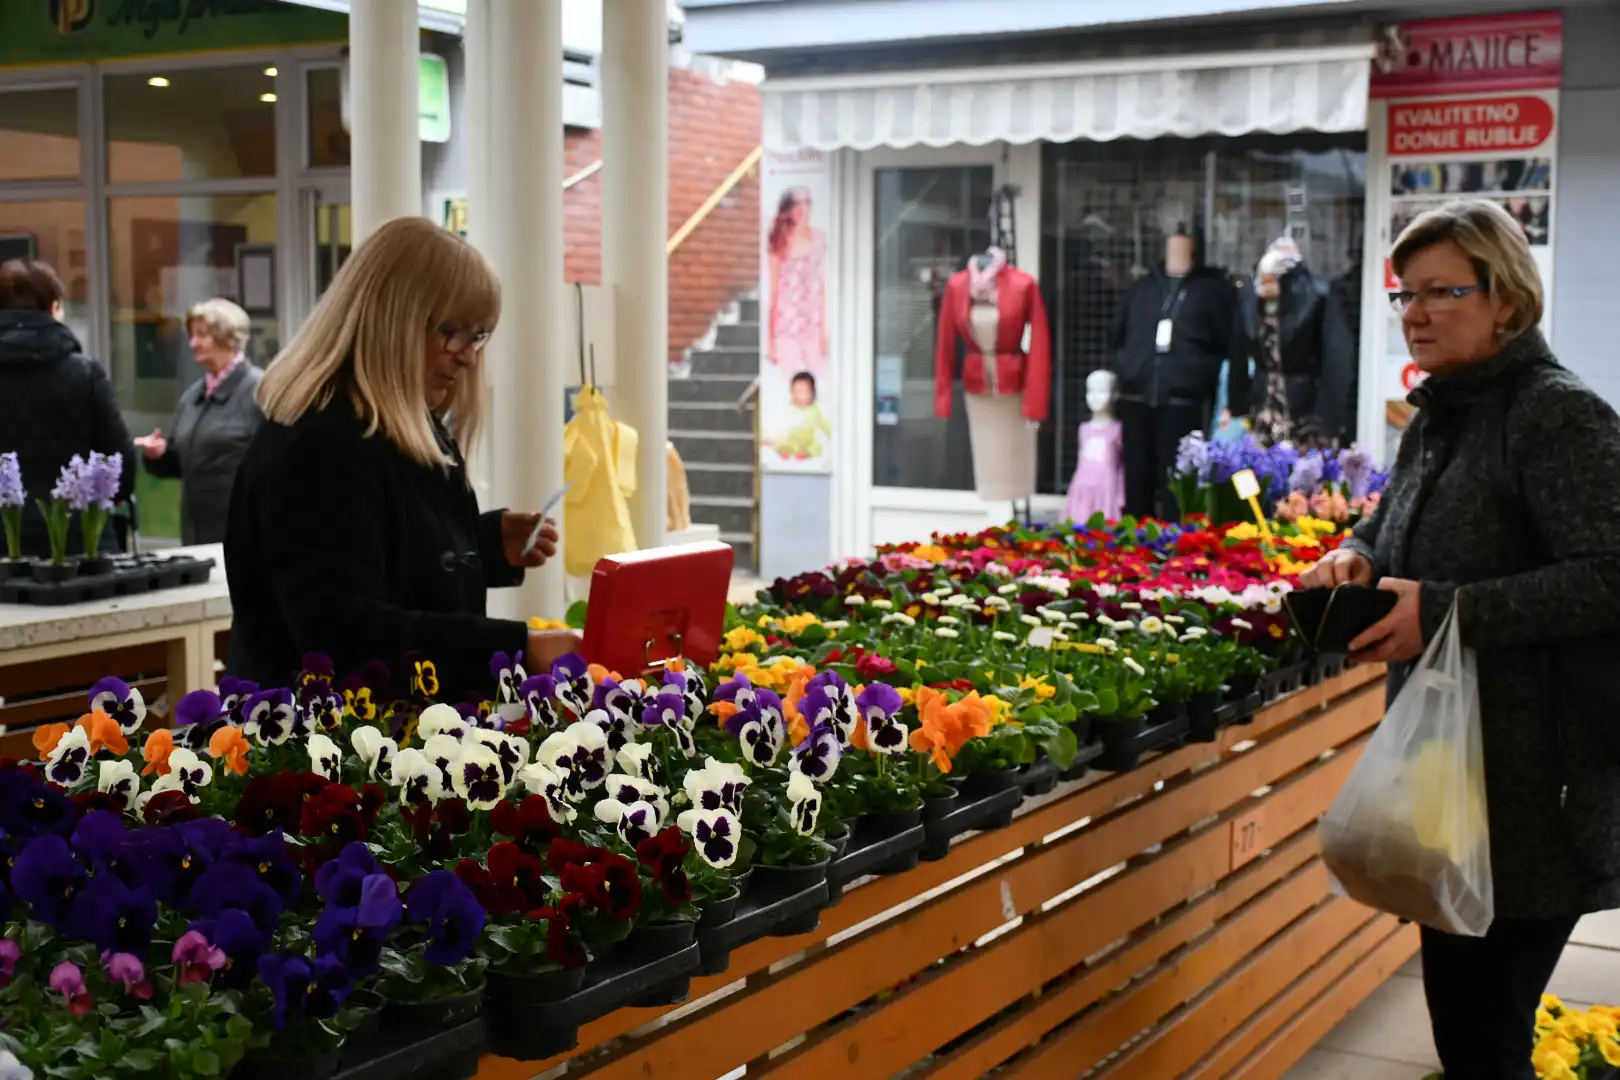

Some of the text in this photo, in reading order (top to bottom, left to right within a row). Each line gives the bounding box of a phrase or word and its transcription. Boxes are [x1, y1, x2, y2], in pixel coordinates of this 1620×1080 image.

[1395, 103, 1519, 126] KVALITETNO
[1395, 125, 1540, 150] DONJE RUBLJE
